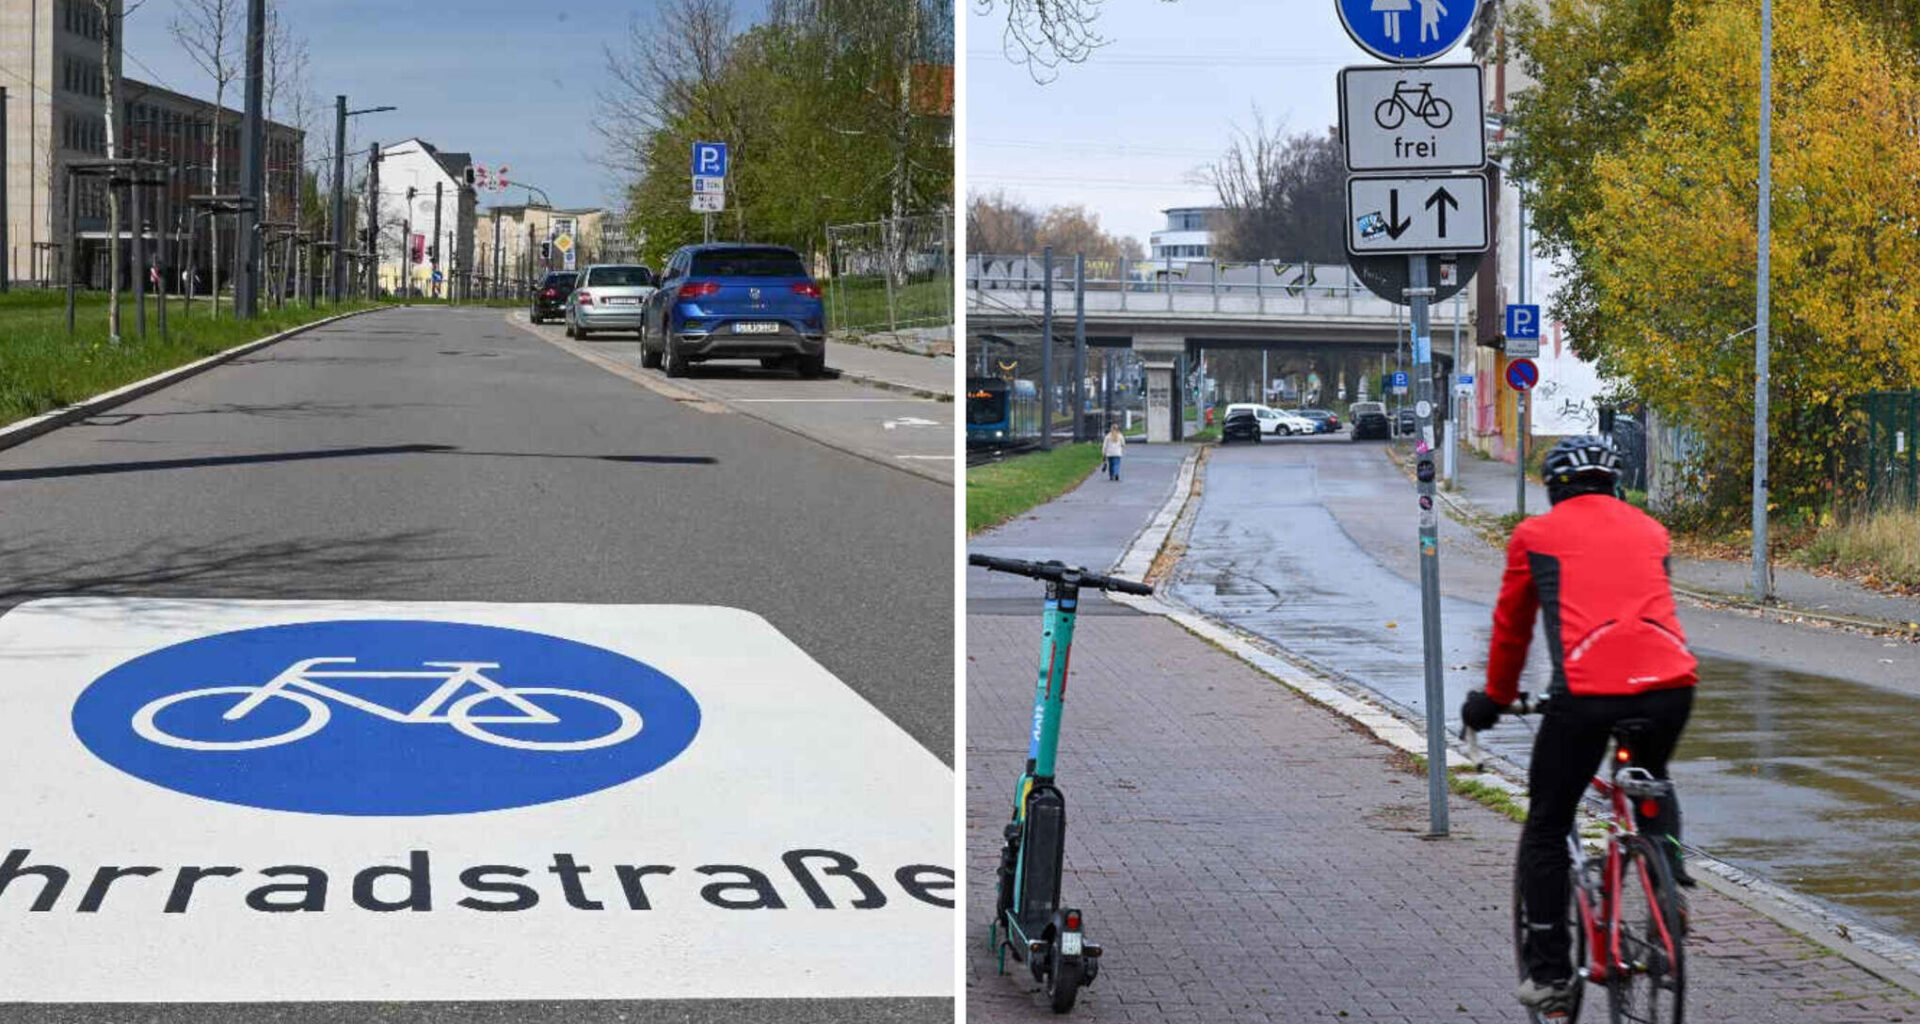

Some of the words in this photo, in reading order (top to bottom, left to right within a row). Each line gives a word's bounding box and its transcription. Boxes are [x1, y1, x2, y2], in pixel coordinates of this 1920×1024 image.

[700, 146, 719, 173] P
[1394, 136, 1436, 158] frei
[1513, 308, 1532, 335] P
